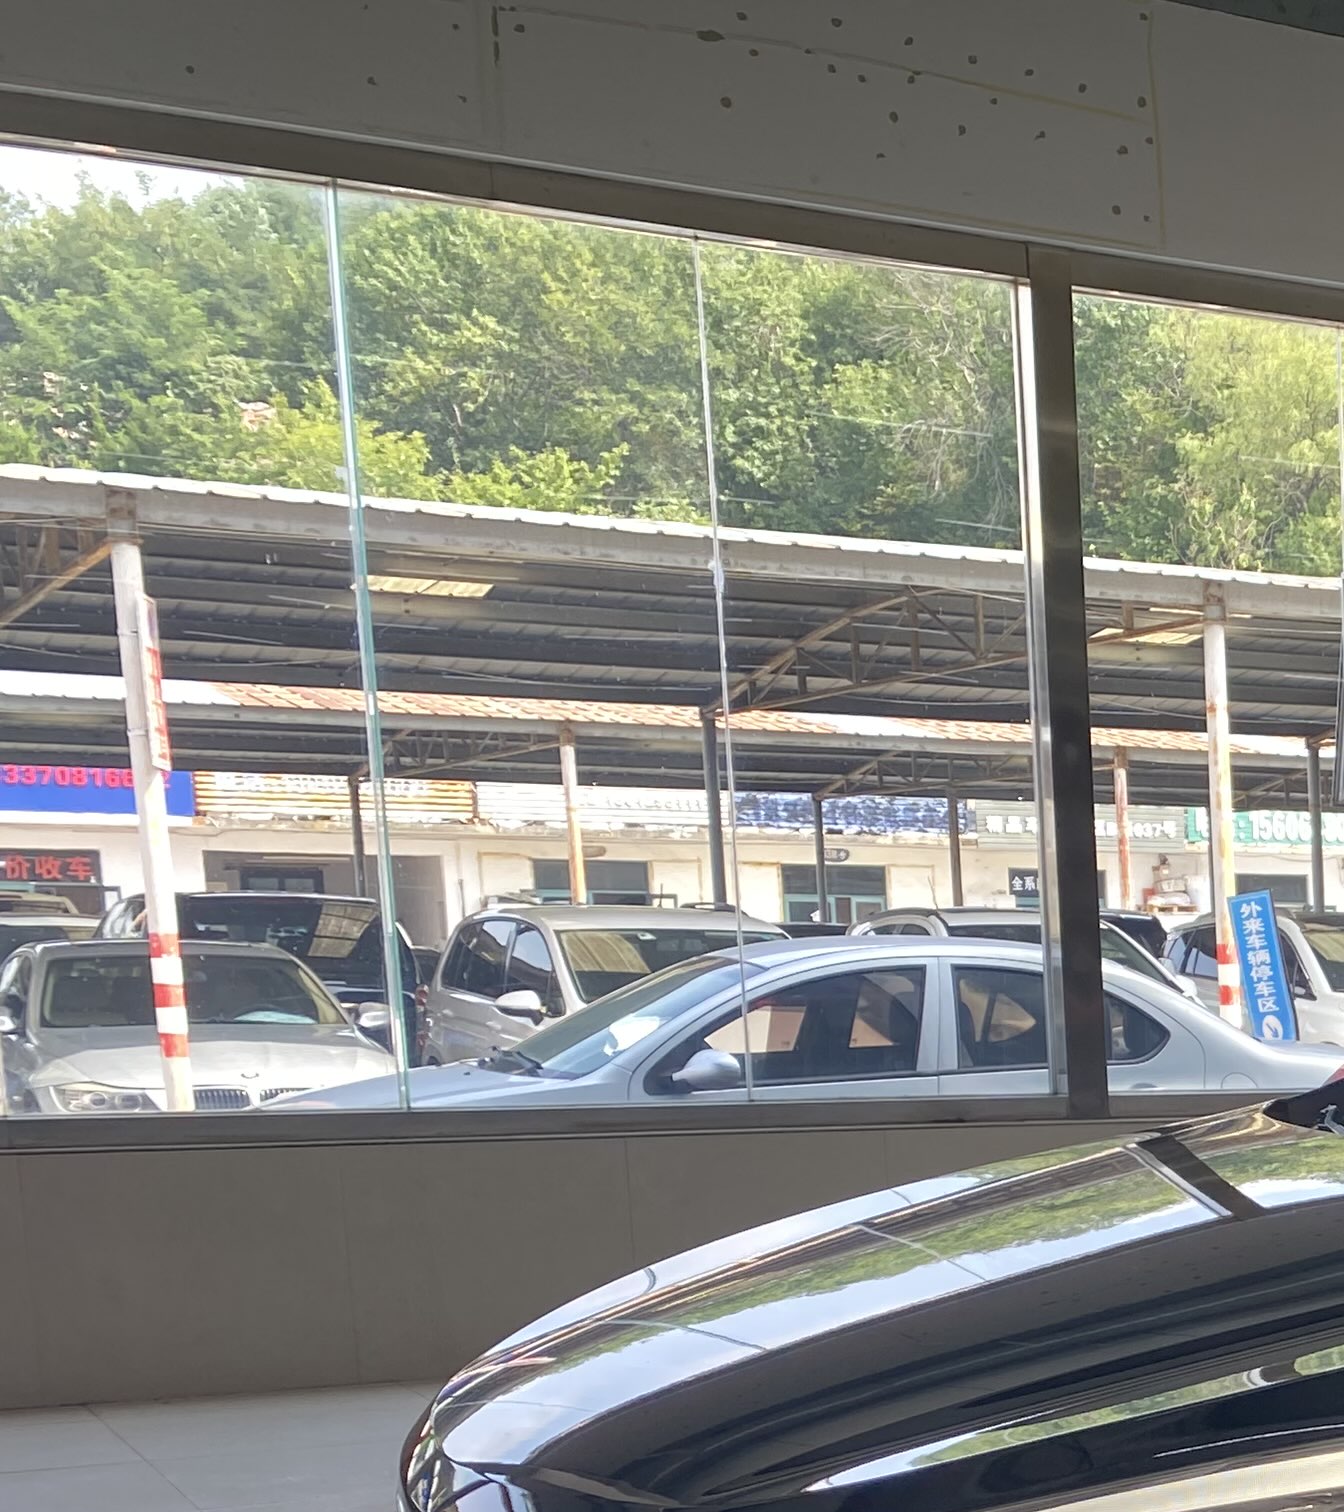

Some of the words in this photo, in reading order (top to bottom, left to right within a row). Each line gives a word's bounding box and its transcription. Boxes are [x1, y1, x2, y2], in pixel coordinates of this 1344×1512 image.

[1011, 875, 1038, 891] 全系
[1240, 901, 1280, 1013] 外来车辆停车区
